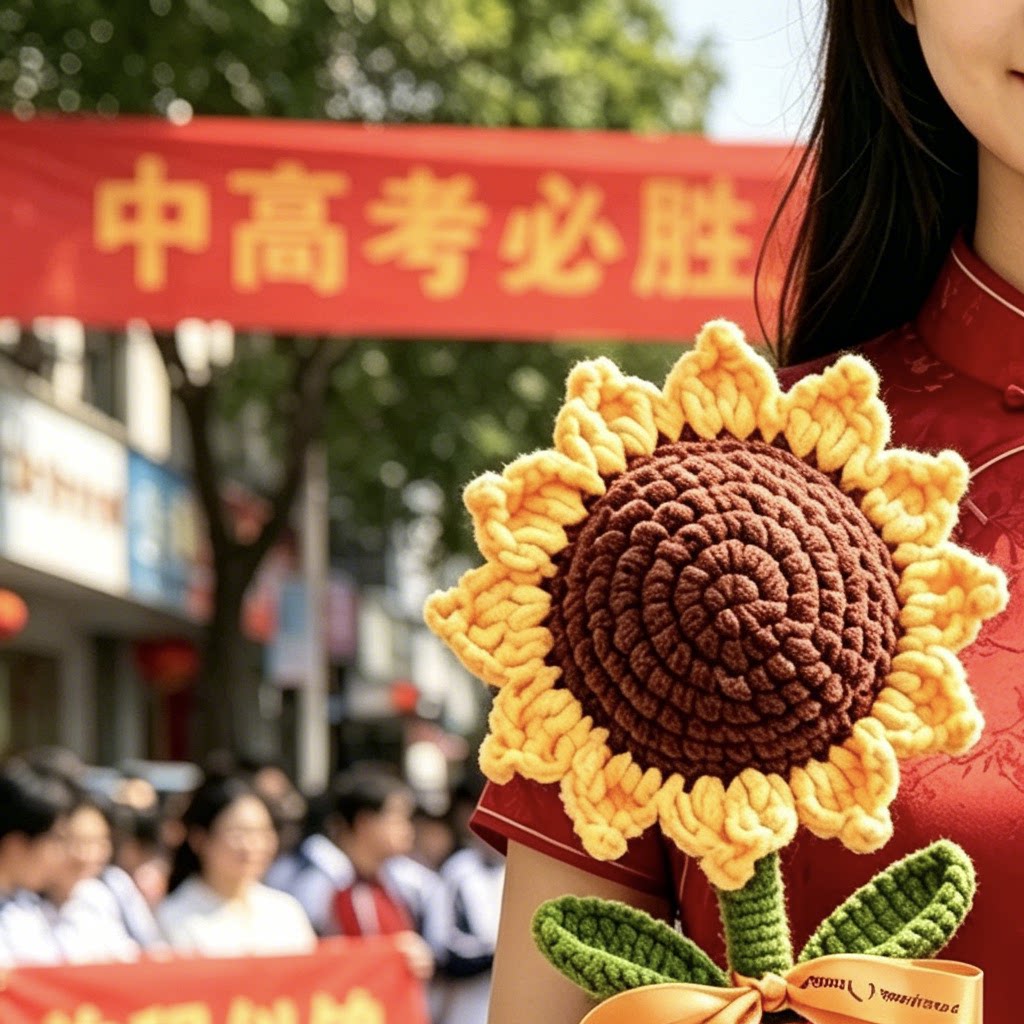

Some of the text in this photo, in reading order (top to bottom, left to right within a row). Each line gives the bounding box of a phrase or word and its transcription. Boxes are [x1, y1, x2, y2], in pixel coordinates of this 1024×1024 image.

[95, 154, 757, 298] 中高考必胜
